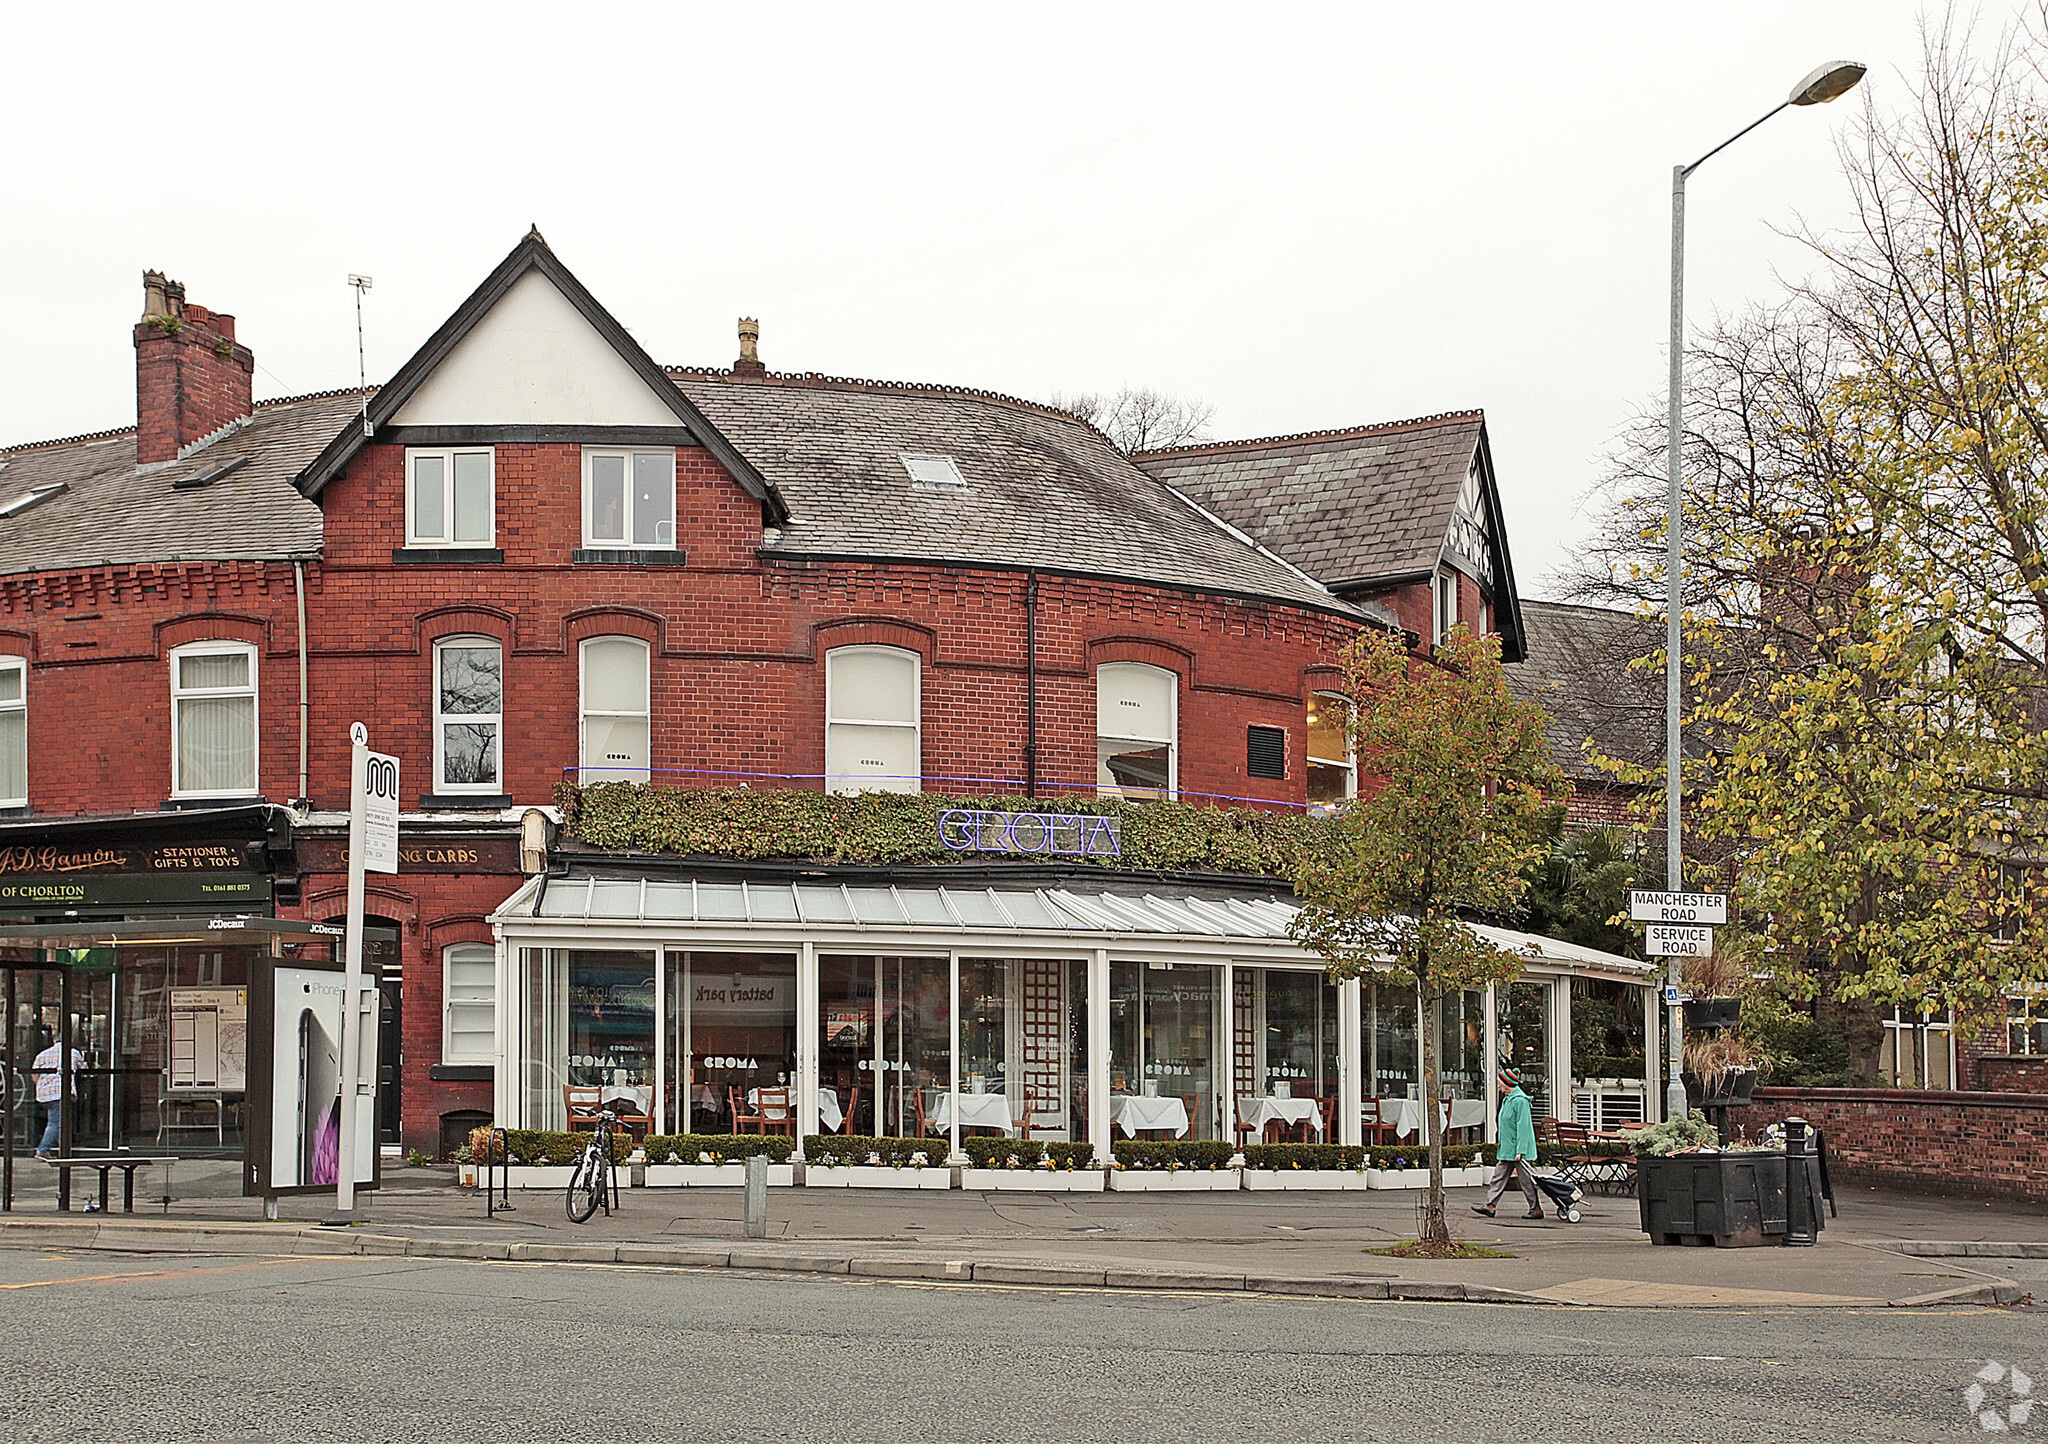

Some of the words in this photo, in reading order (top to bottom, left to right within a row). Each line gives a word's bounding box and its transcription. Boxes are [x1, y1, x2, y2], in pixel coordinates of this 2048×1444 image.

[355, 726, 364, 742] A
[939, 809, 1121, 856] CROMA
[163, 847, 228, 857] STATIONER
[427, 849, 478, 863] CARDS
[155, 858, 188, 868] GIFTS
[193, 857, 203, 867] &
[209, 856, 239, 867] TOYS
[2, 886, 17, 897] OF
[20, 885, 84, 897] CHORLTON
[1635, 893, 1722, 907] MANCHESTER
[1661, 908, 1696, 920] ROAD
[208, 919, 245, 929] JCDecaux
[309, 924, 345, 935] JCDecaux
[1652, 927, 1706, 941] SERVICE
[1662, 942, 1697, 954] ROAD
[704, 1057, 758, 1068] CROMA
[1145, 1064, 1191, 1076] CROMA
